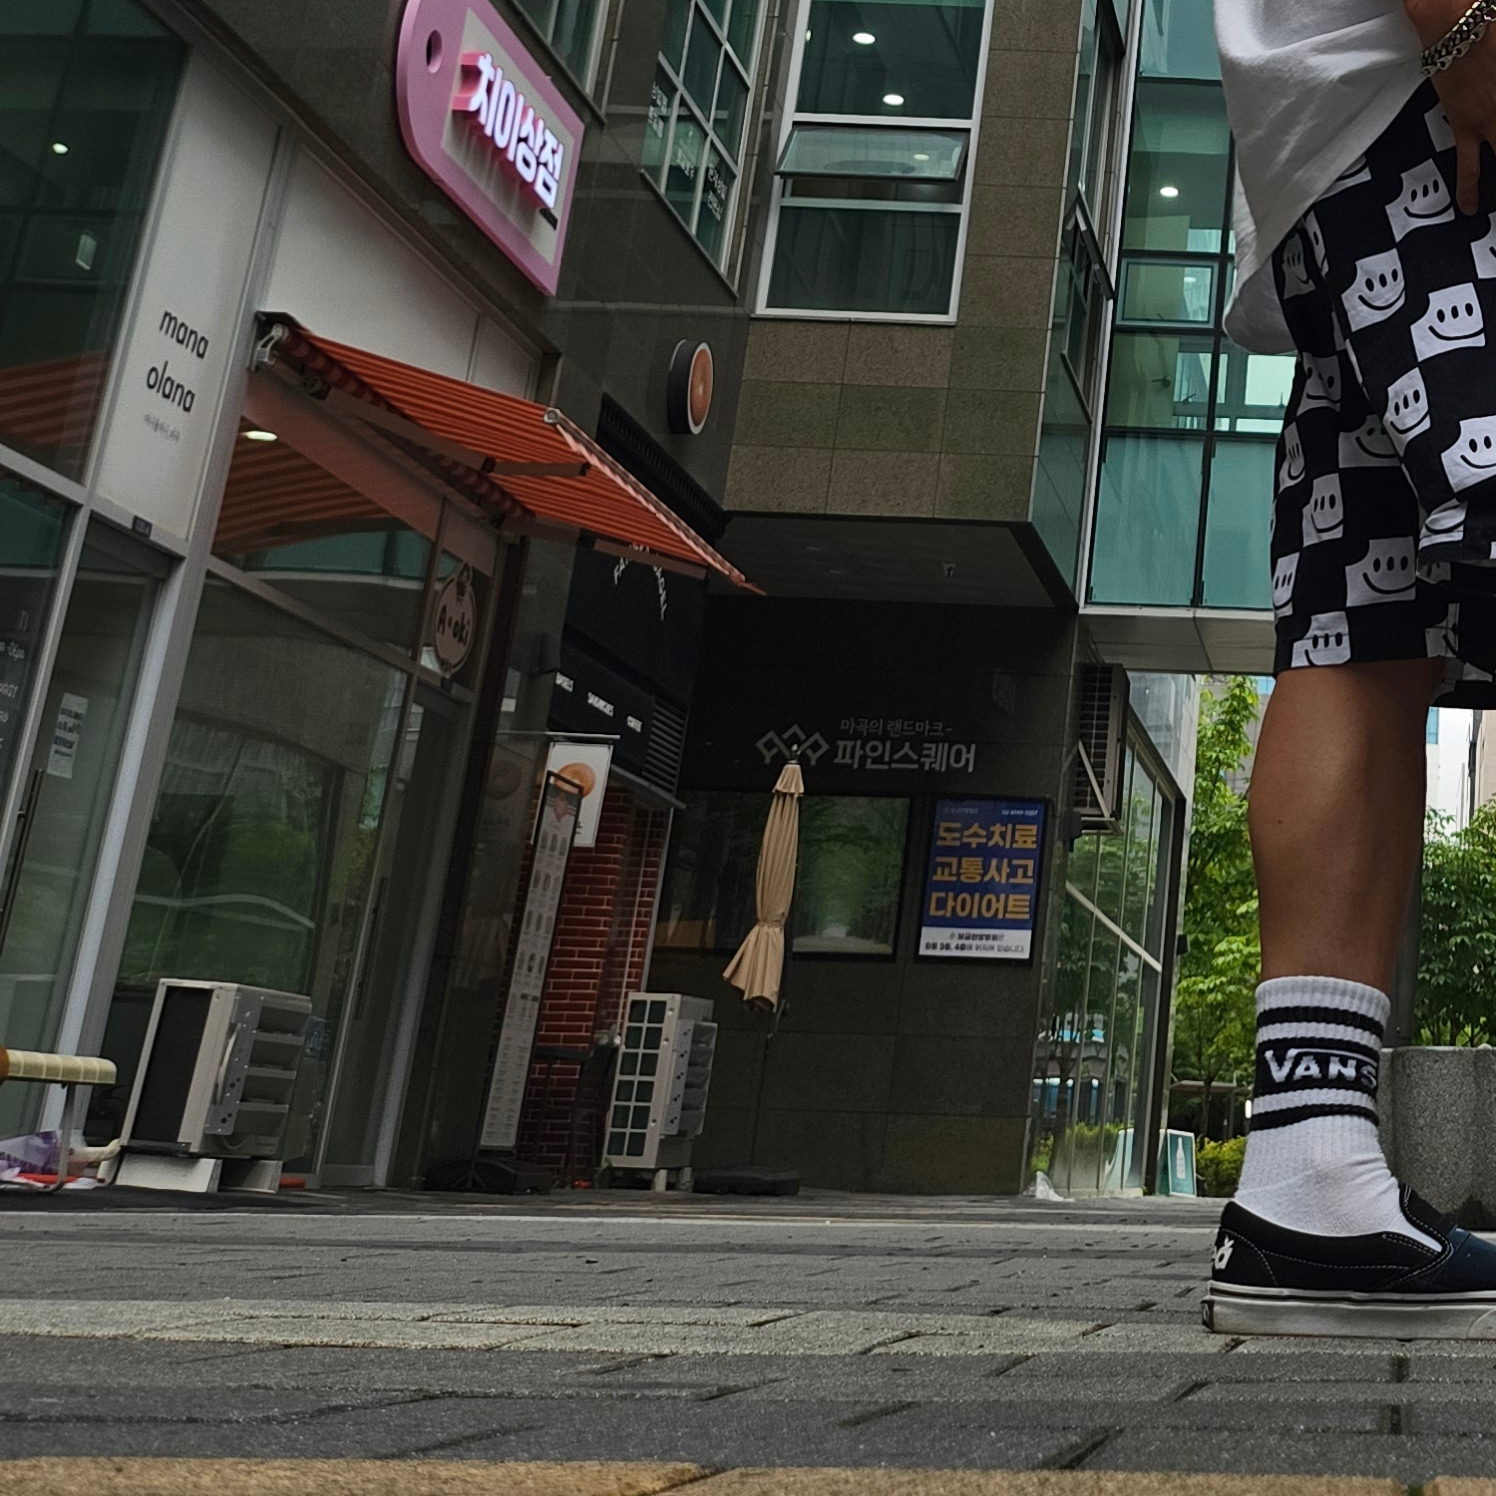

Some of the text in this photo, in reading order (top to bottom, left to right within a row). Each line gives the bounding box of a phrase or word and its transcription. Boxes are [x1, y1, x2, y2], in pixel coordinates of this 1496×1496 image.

[159, 310, 209, 359] mana
[146, 360, 195, 413] olana
[841, 717, 882, 737] 마곡의
[833, 739, 977, 773] 파인스퀘어
[936, 821, 1038, 849] 도수치료
[932, 856, 1034, 884] 교통사고
[929, 891, 1031, 919] 다이어트
[1264, 1047, 1378, 1087] VANS
